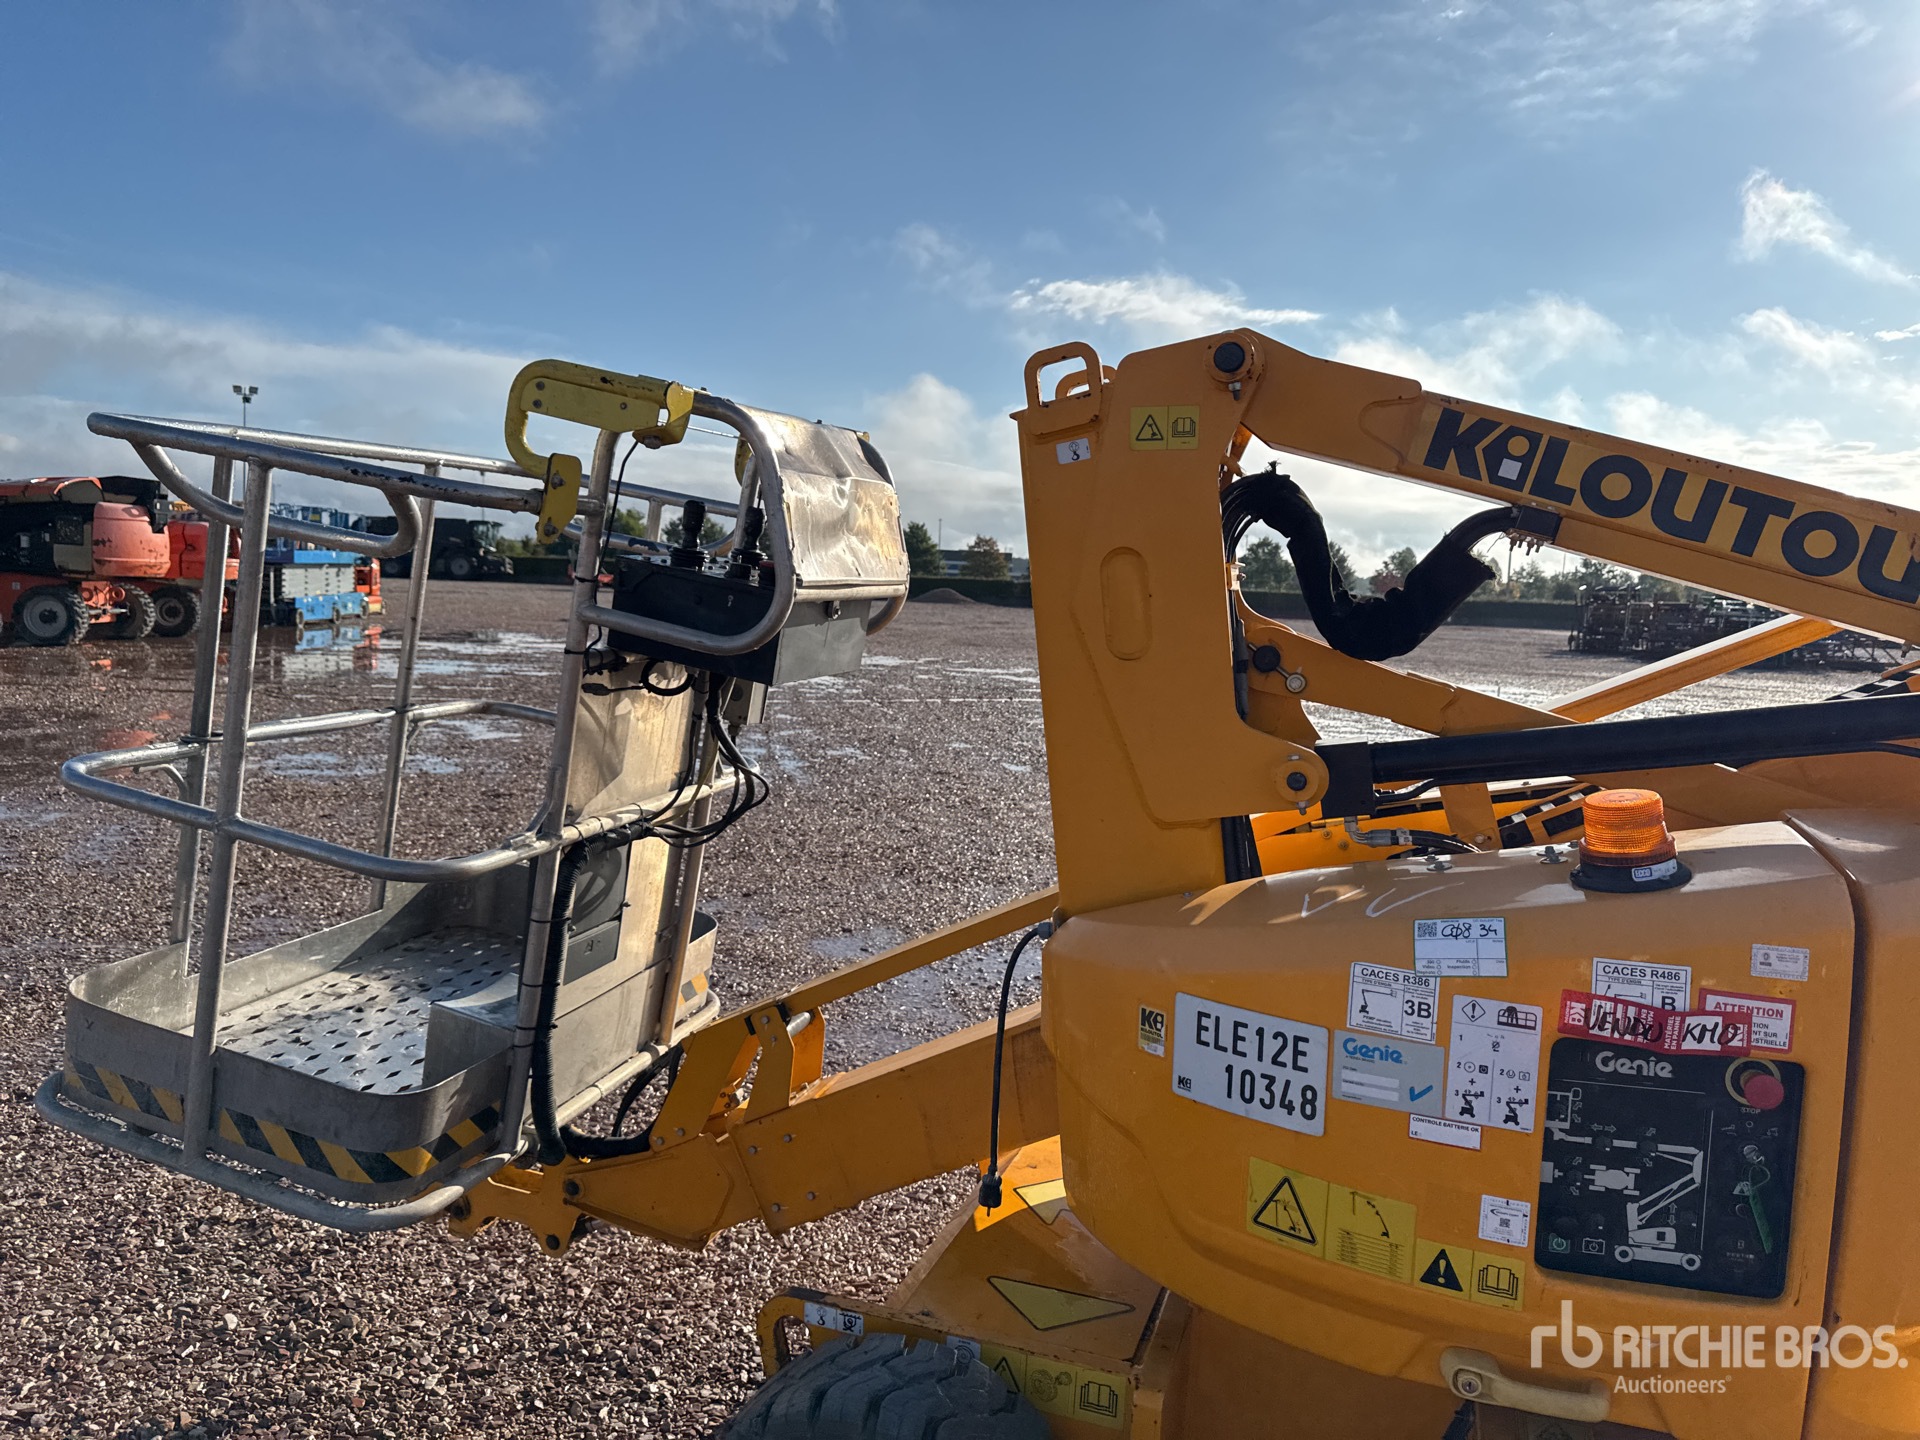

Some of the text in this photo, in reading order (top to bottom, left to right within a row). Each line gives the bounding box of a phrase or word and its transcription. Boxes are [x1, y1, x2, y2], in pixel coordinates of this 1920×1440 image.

[1479, 924, 1498, 937] 34
[1361, 967, 1430, 988] CACES R386
[1603, 965, 1681, 981] CACES R486
[1404, 1000, 1431, 1019] 3B
[1672, 1016, 1681, 1037] PANNE
[1196, 1010, 1310, 1073] ELE12E
[1343, 1037, 1403, 1064] Genie
[1595, 1051, 1673, 1078] Genie
[1225, 1064, 1318, 1121] 10348
[1412, 1116, 1442, 1127] CONTROLE
[1443, 1121, 1470, 1132] BATTERIE
